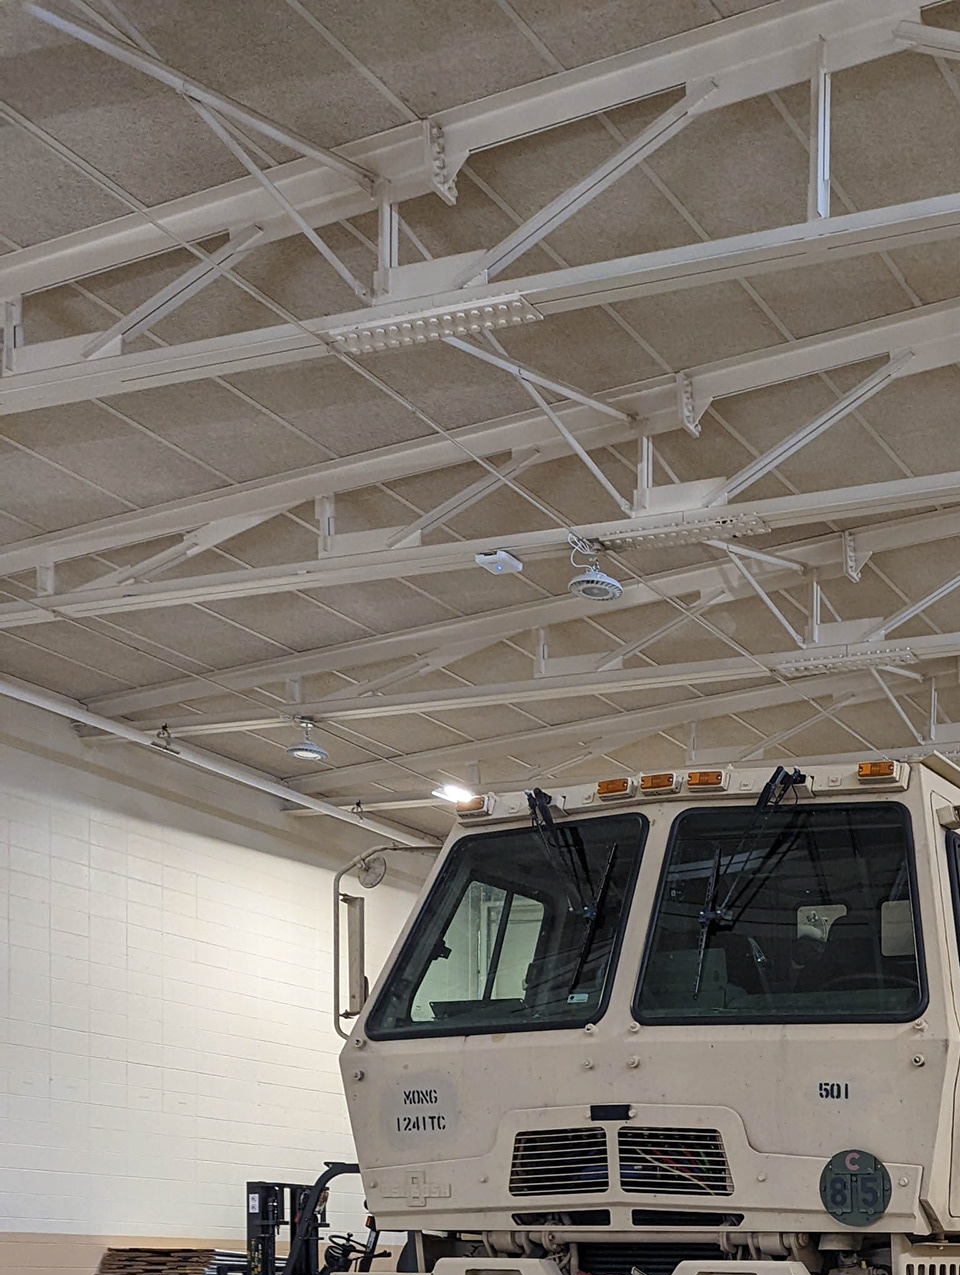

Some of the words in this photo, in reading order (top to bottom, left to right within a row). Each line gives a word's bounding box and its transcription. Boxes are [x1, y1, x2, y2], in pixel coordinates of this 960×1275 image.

[403, 1089, 438, 1105] MONG
[818, 1082, 849, 1100] 501
[397, 1115, 446, 1132] 1241TC
[844, 1152, 861, 1172] C
